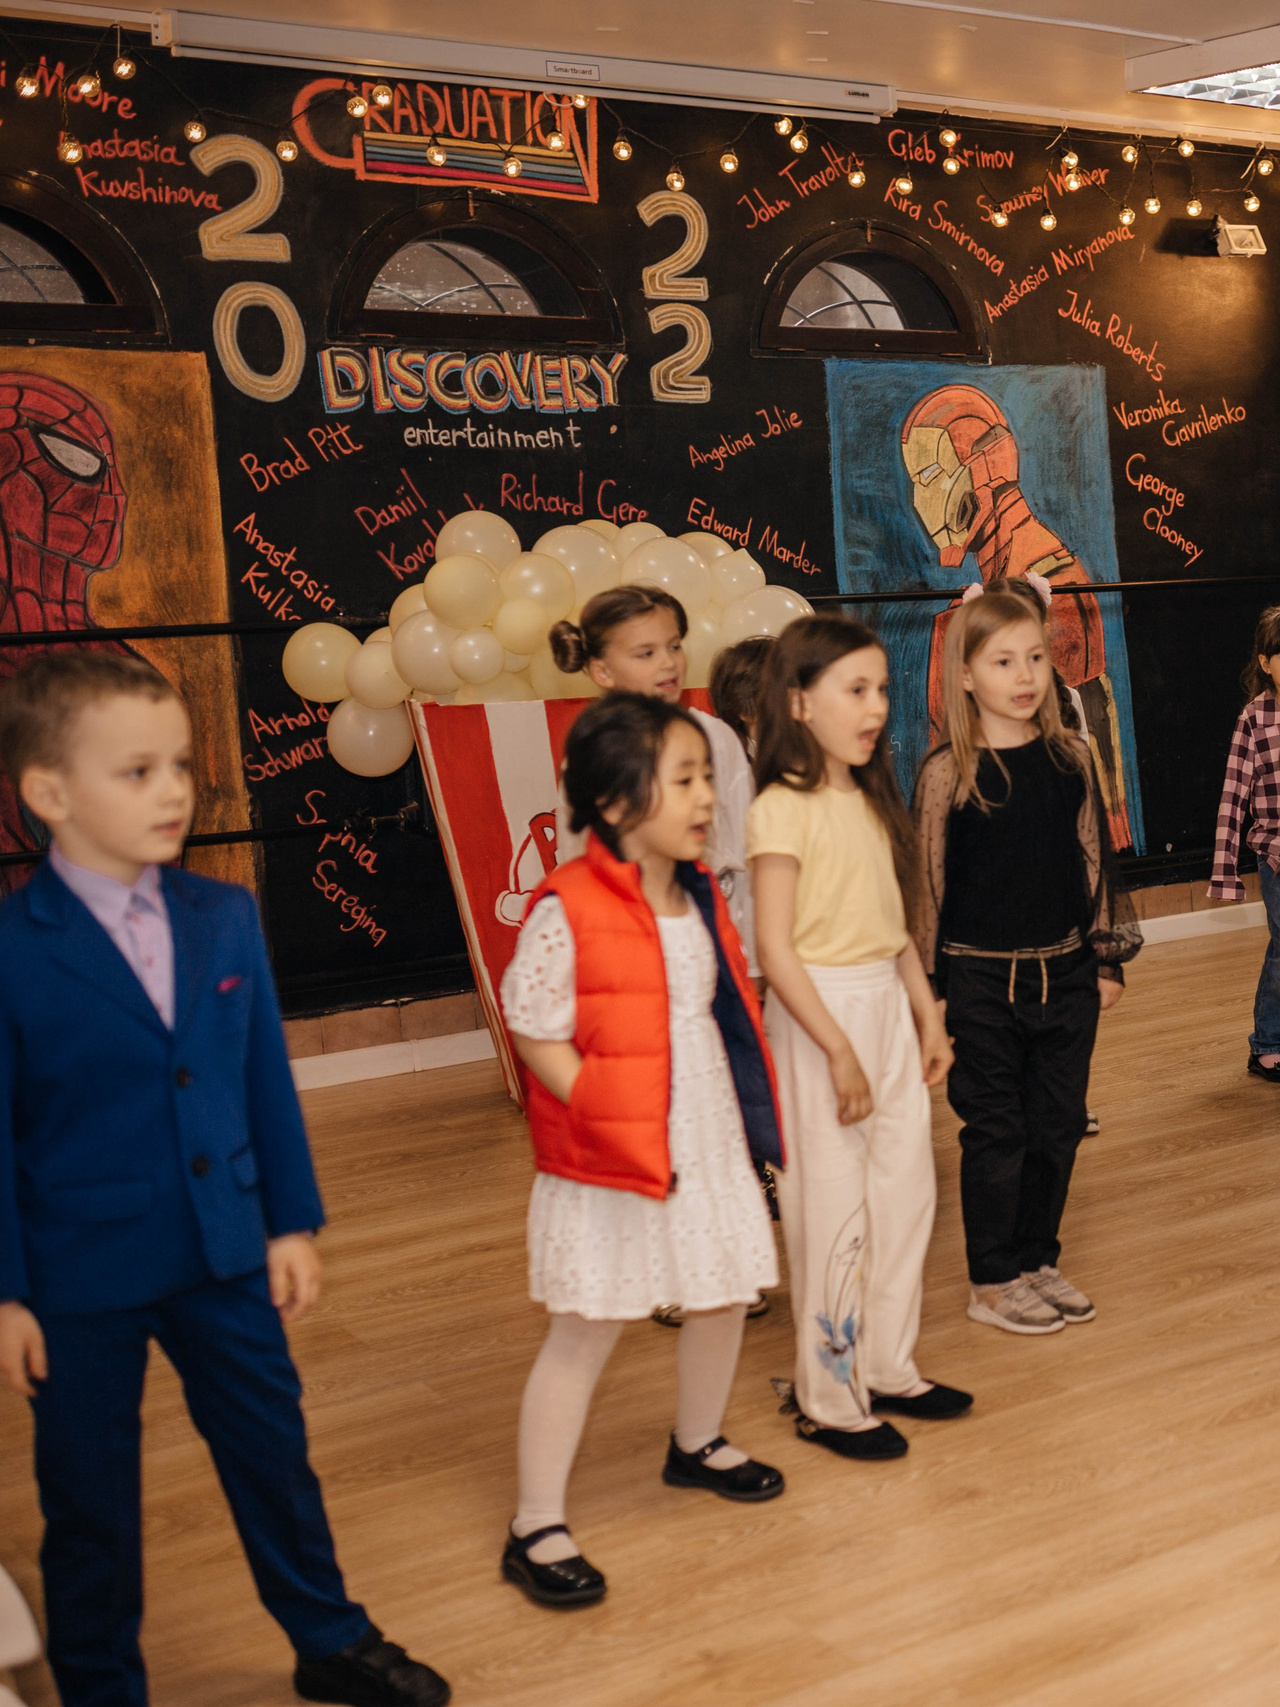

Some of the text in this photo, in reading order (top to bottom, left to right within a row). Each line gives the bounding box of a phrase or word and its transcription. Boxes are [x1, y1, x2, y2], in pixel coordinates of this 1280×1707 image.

[292, 77, 600, 204] GRADUATION
[888, 129, 936, 164] Gleb
[75, 166, 222, 211] Kuvshinova
[737, 188, 791, 229] John
[884, 177, 1005, 277] Kira Smirnova
[984, 265, 1050, 324] Anastasia
[1058, 290, 1166, 382] Julia Roberts
[316, 347, 628, 414] DISCOVERY
[1113, 390, 1186, 430] Veronika
[403, 418, 582, 449] entertainment
[688, 405, 803, 471] Angelina Jolie
[1162, 397, 1247, 447] Gavrilenko
[240, 422, 364, 492] Brad Pitt
[1125, 453, 1185, 516] George
[501, 469, 649, 522] Richard Gere
[233, 512, 336, 612] Anastasia
[686, 497, 822, 577] Edward Marder
[1143, 508, 1204, 567] Clooney
[248, 696, 331, 743] Arnold
[243, 736, 331, 781] Schwar
